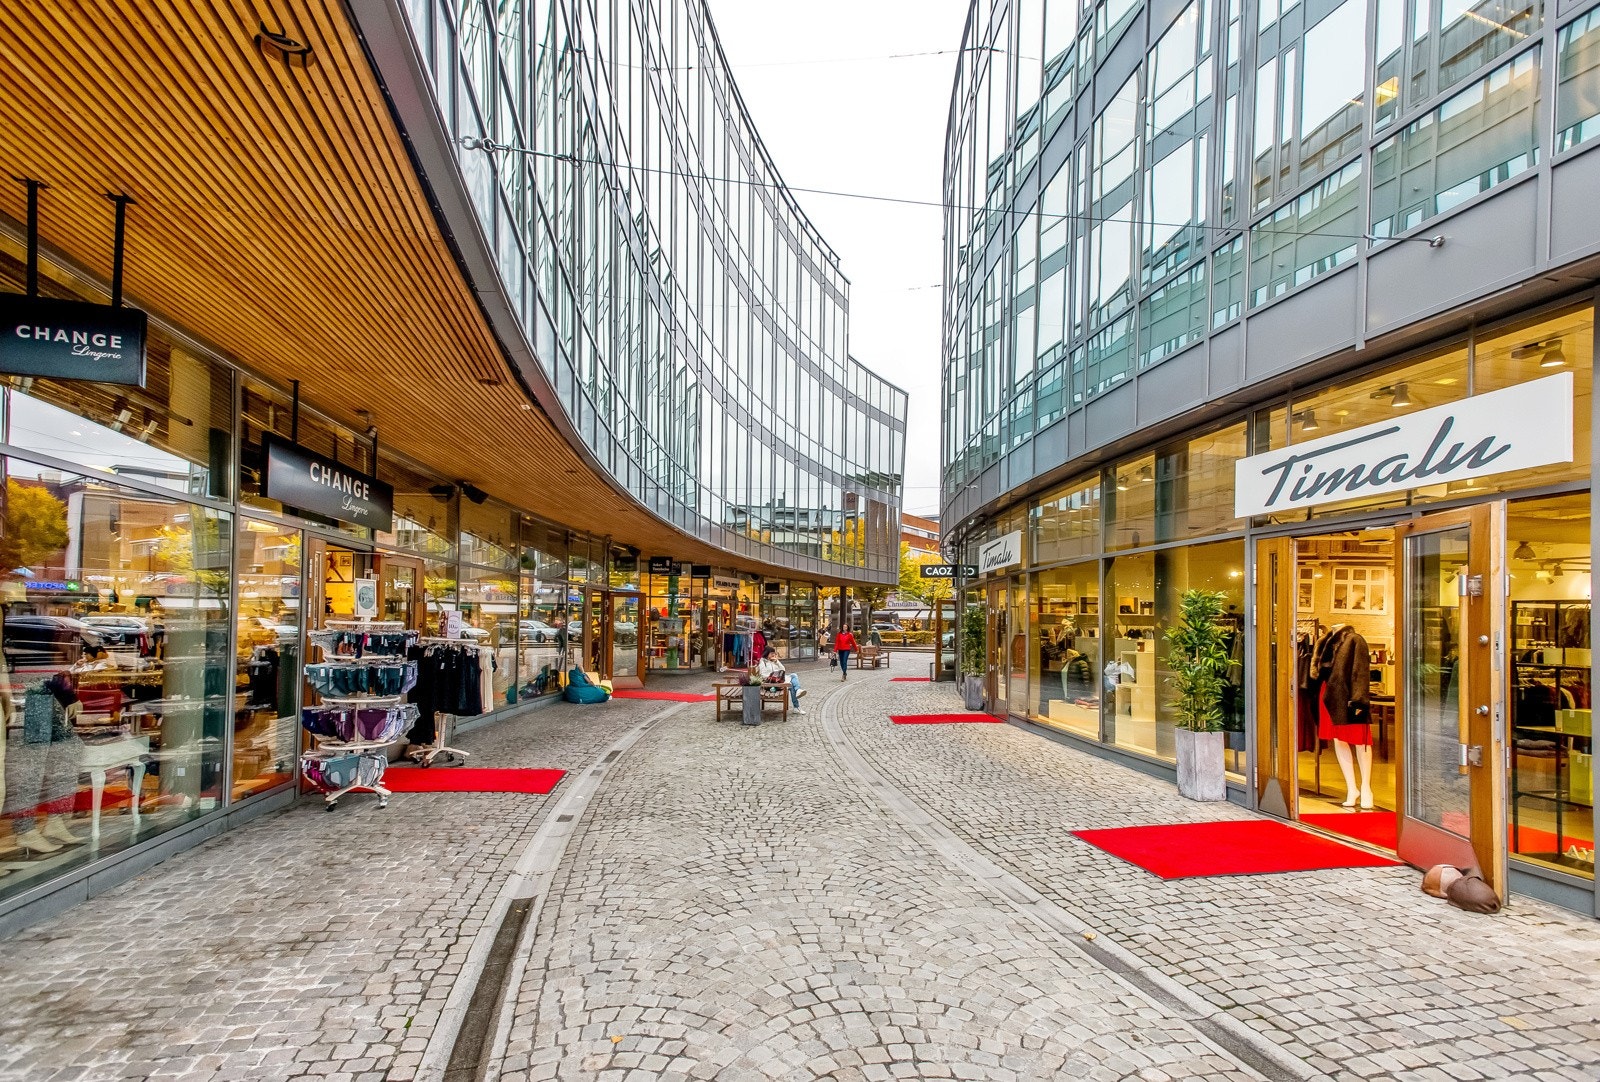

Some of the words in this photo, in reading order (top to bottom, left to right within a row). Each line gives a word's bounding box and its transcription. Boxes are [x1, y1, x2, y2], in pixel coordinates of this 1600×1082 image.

[15, 325, 122, 349] CHANGE
[71, 344, 122, 361] Lingerie
[1261, 415, 1511, 507] Timalu
[309, 462, 370, 501] CHANGE
[341, 494, 369, 517] Lingerie
[982, 541, 1013, 570] Timalu
[925, 566, 953, 576] CAOZ
